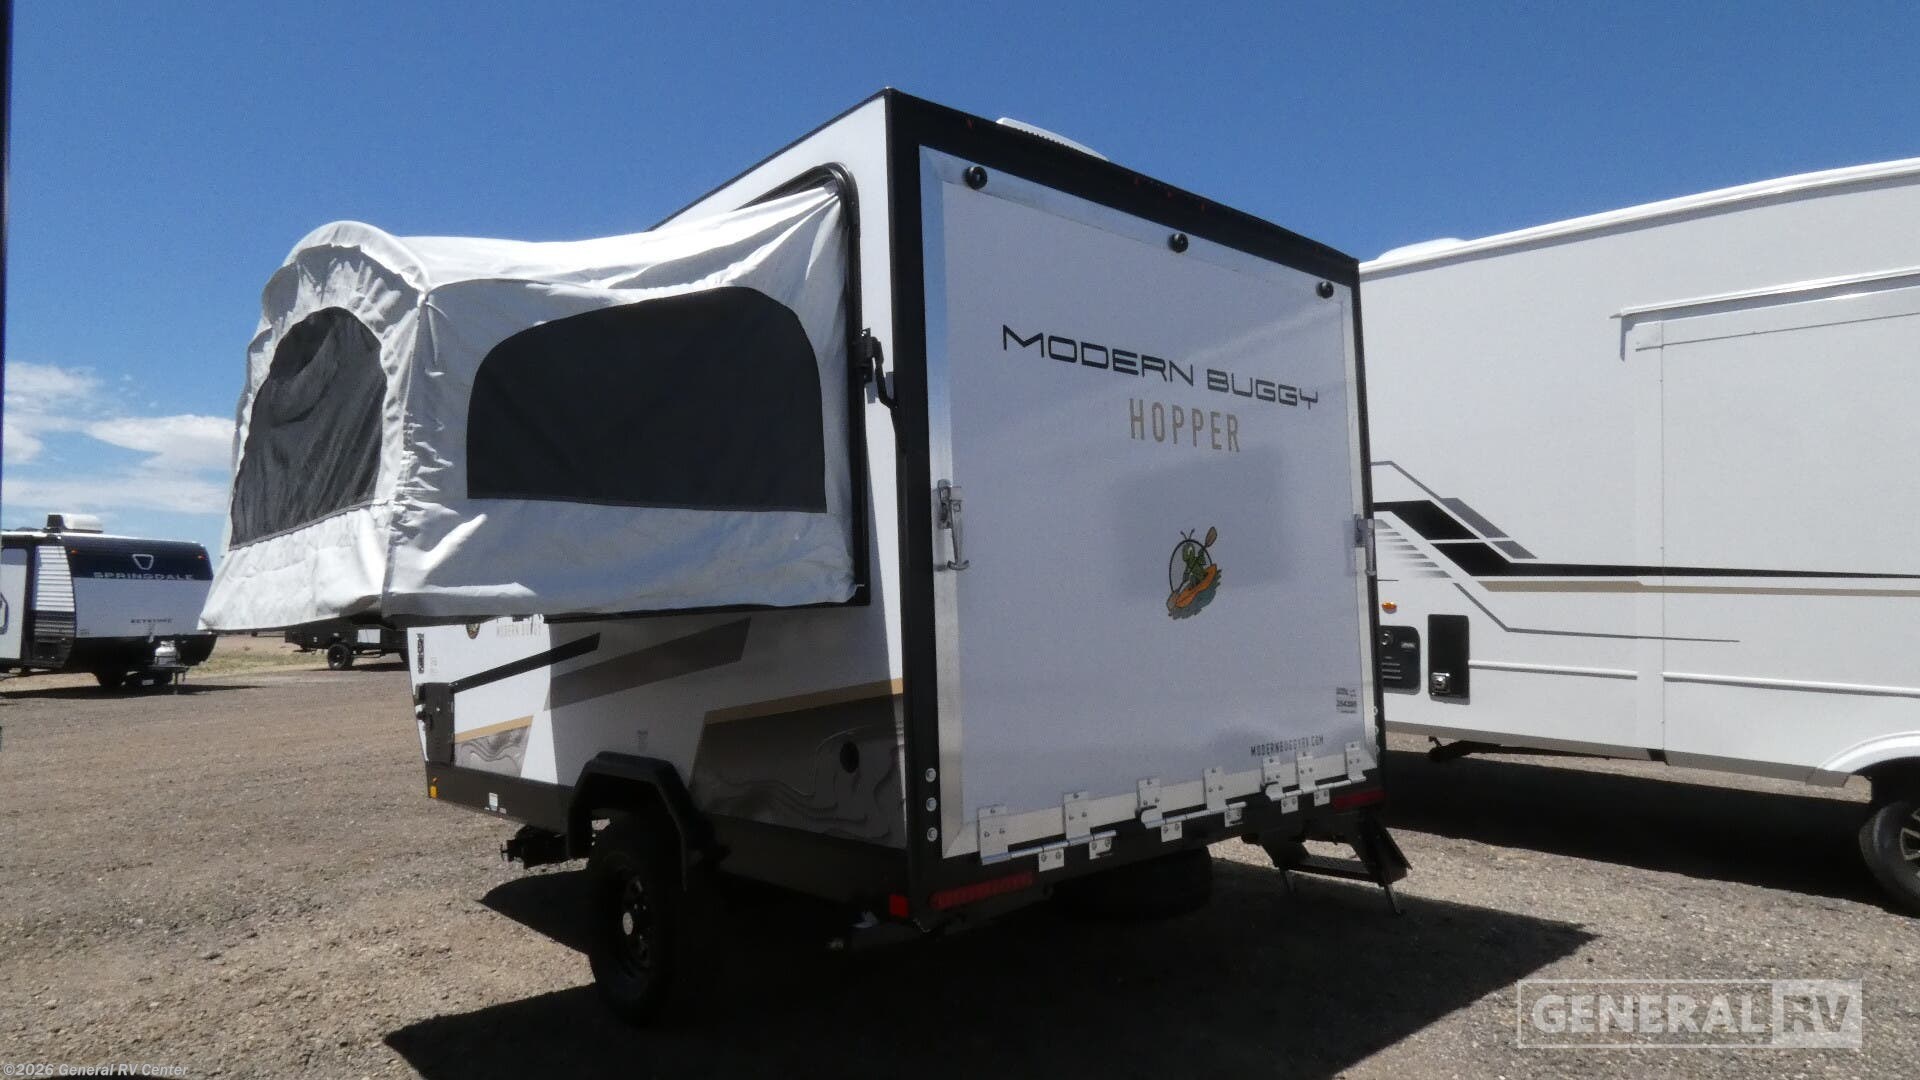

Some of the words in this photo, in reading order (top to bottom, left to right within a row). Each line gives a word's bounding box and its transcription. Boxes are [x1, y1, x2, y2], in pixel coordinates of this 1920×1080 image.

[1002, 324, 1194, 387] MODERN
[1206, 368, 1319, 410] BUGGY
[1129, 398, 1240, 453] HOPPER
[93, 571, 194, 581] SPRINGDALE
